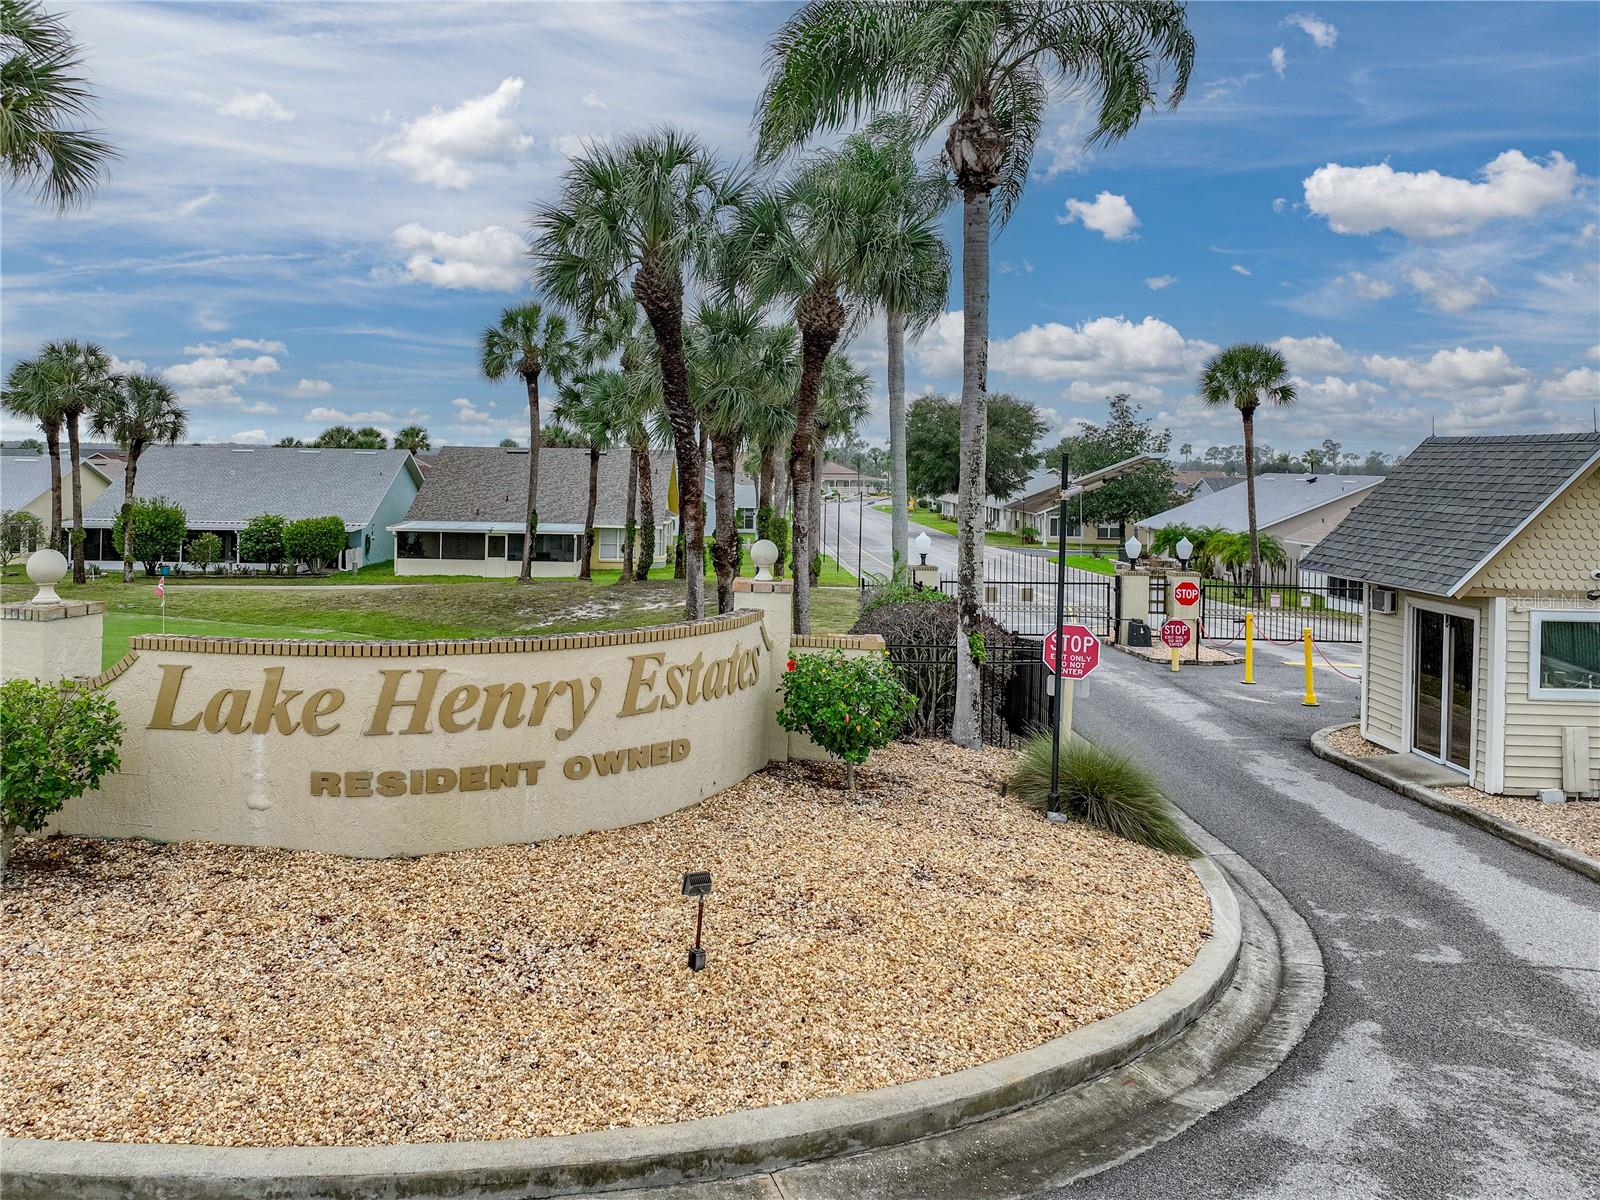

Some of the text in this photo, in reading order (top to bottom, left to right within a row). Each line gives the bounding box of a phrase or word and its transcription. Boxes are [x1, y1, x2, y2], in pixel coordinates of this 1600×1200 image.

[1175, 588, 1198, 599] STOP
[1164, 625, 1188, 635] STOP
[145, 643, 760, 741] Lake Henry Estates
[310, 738, 691, 798] RESIDENT OWNED
